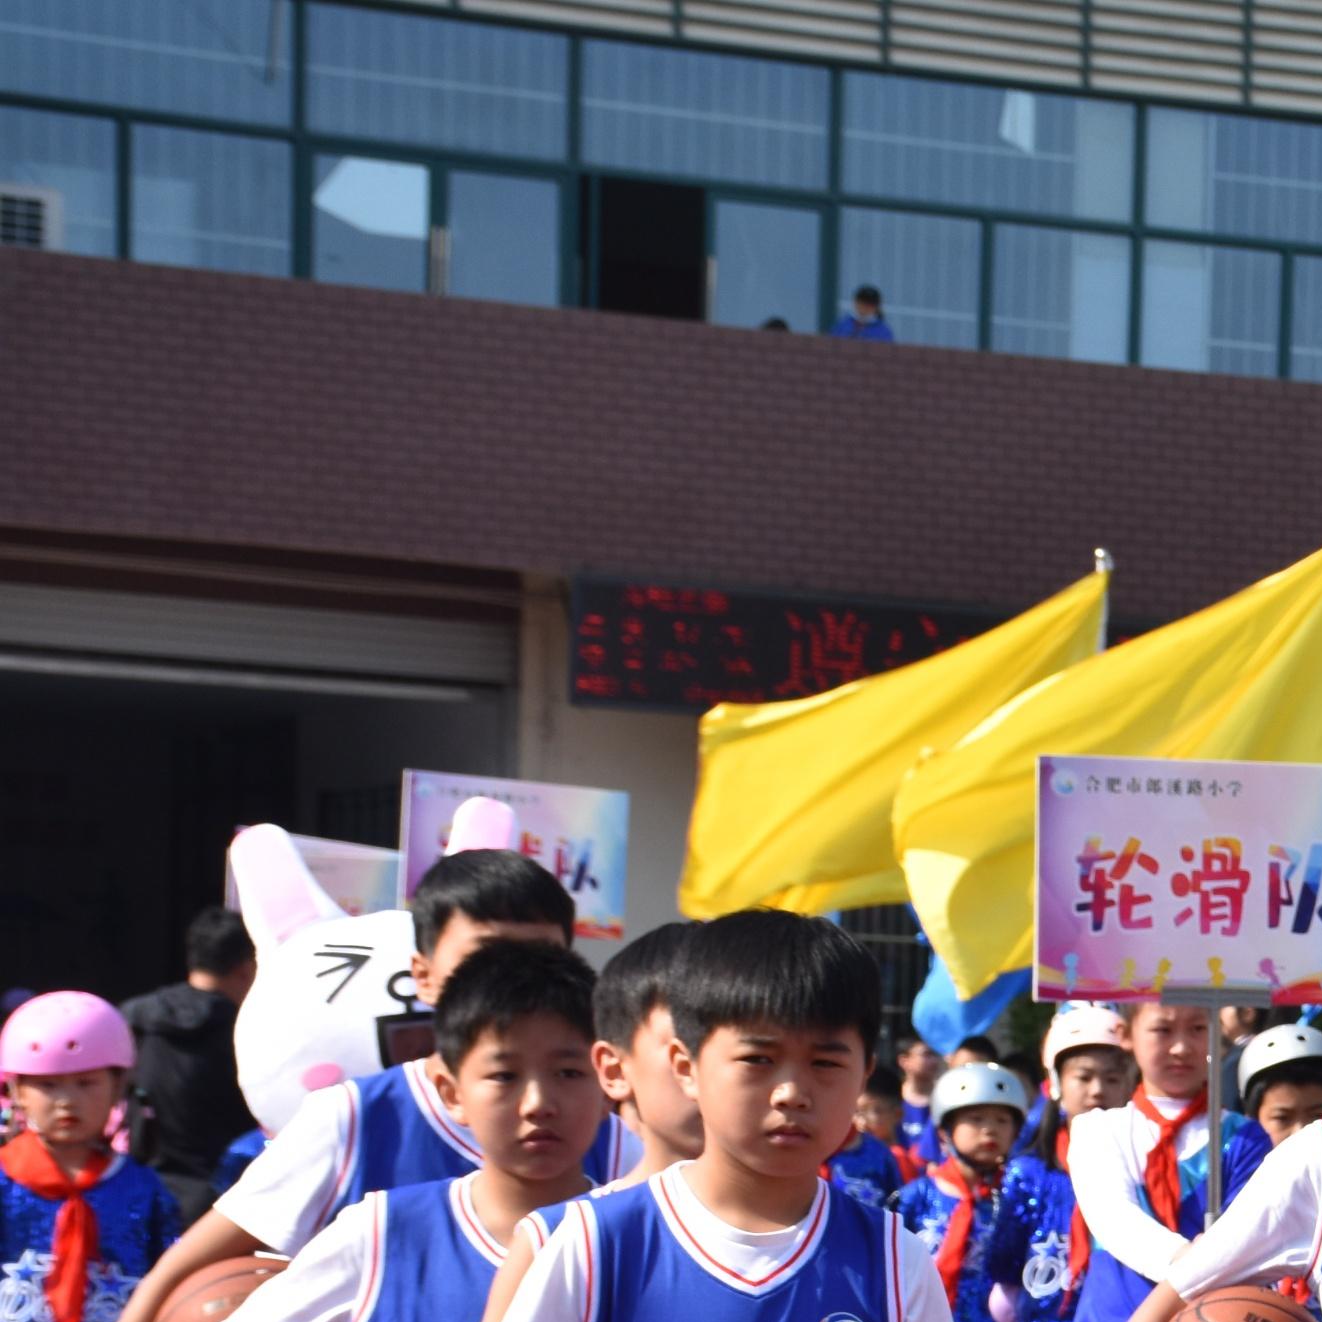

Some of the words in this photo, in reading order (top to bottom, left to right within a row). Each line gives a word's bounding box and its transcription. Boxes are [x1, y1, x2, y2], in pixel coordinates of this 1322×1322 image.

[1085, 775, 1243, 798] 合肥市郎溪路小学
